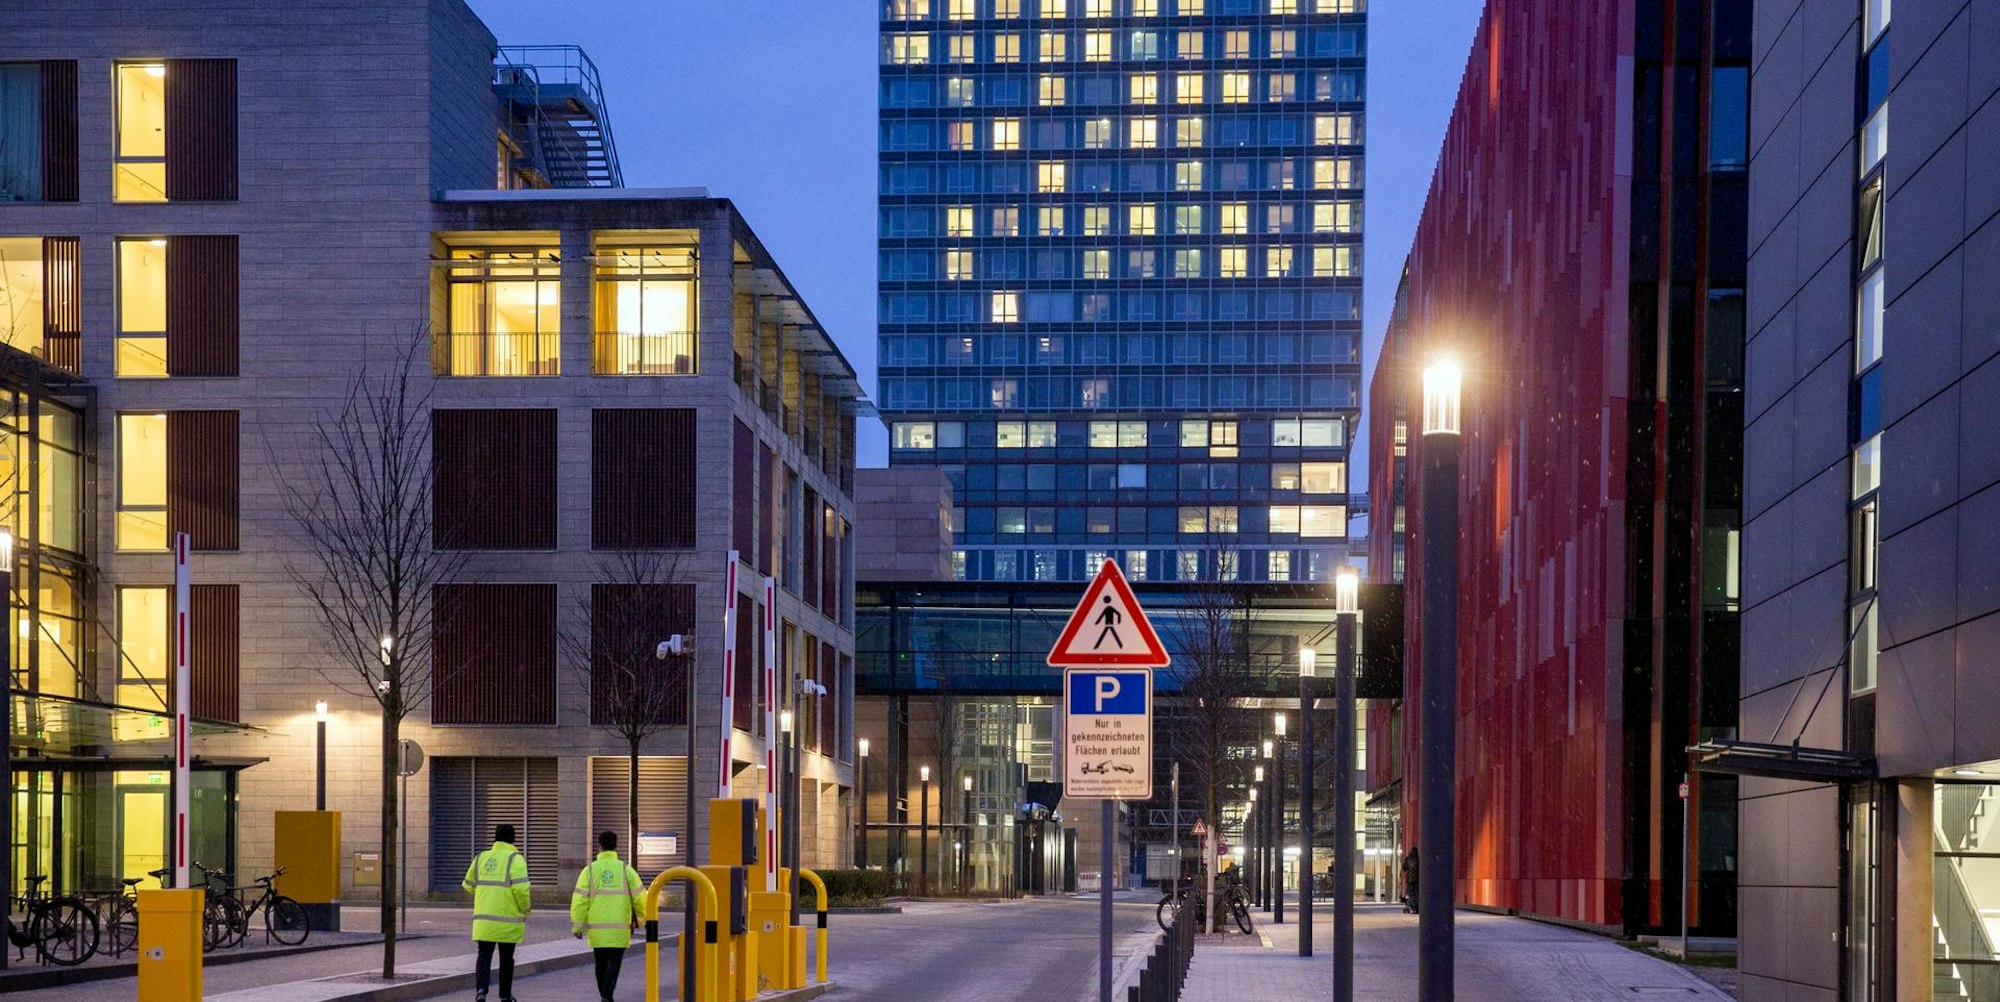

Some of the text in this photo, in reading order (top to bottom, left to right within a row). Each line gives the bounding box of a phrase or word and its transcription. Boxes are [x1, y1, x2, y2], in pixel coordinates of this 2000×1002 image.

[1095, 676, 1121, 712] P
[1095, 719, 1121, 728] Nur in
[1072, 732, 1145, 743] gekennzeichneten
[1075, 745, 1141, 755] Flächen erlaubt
